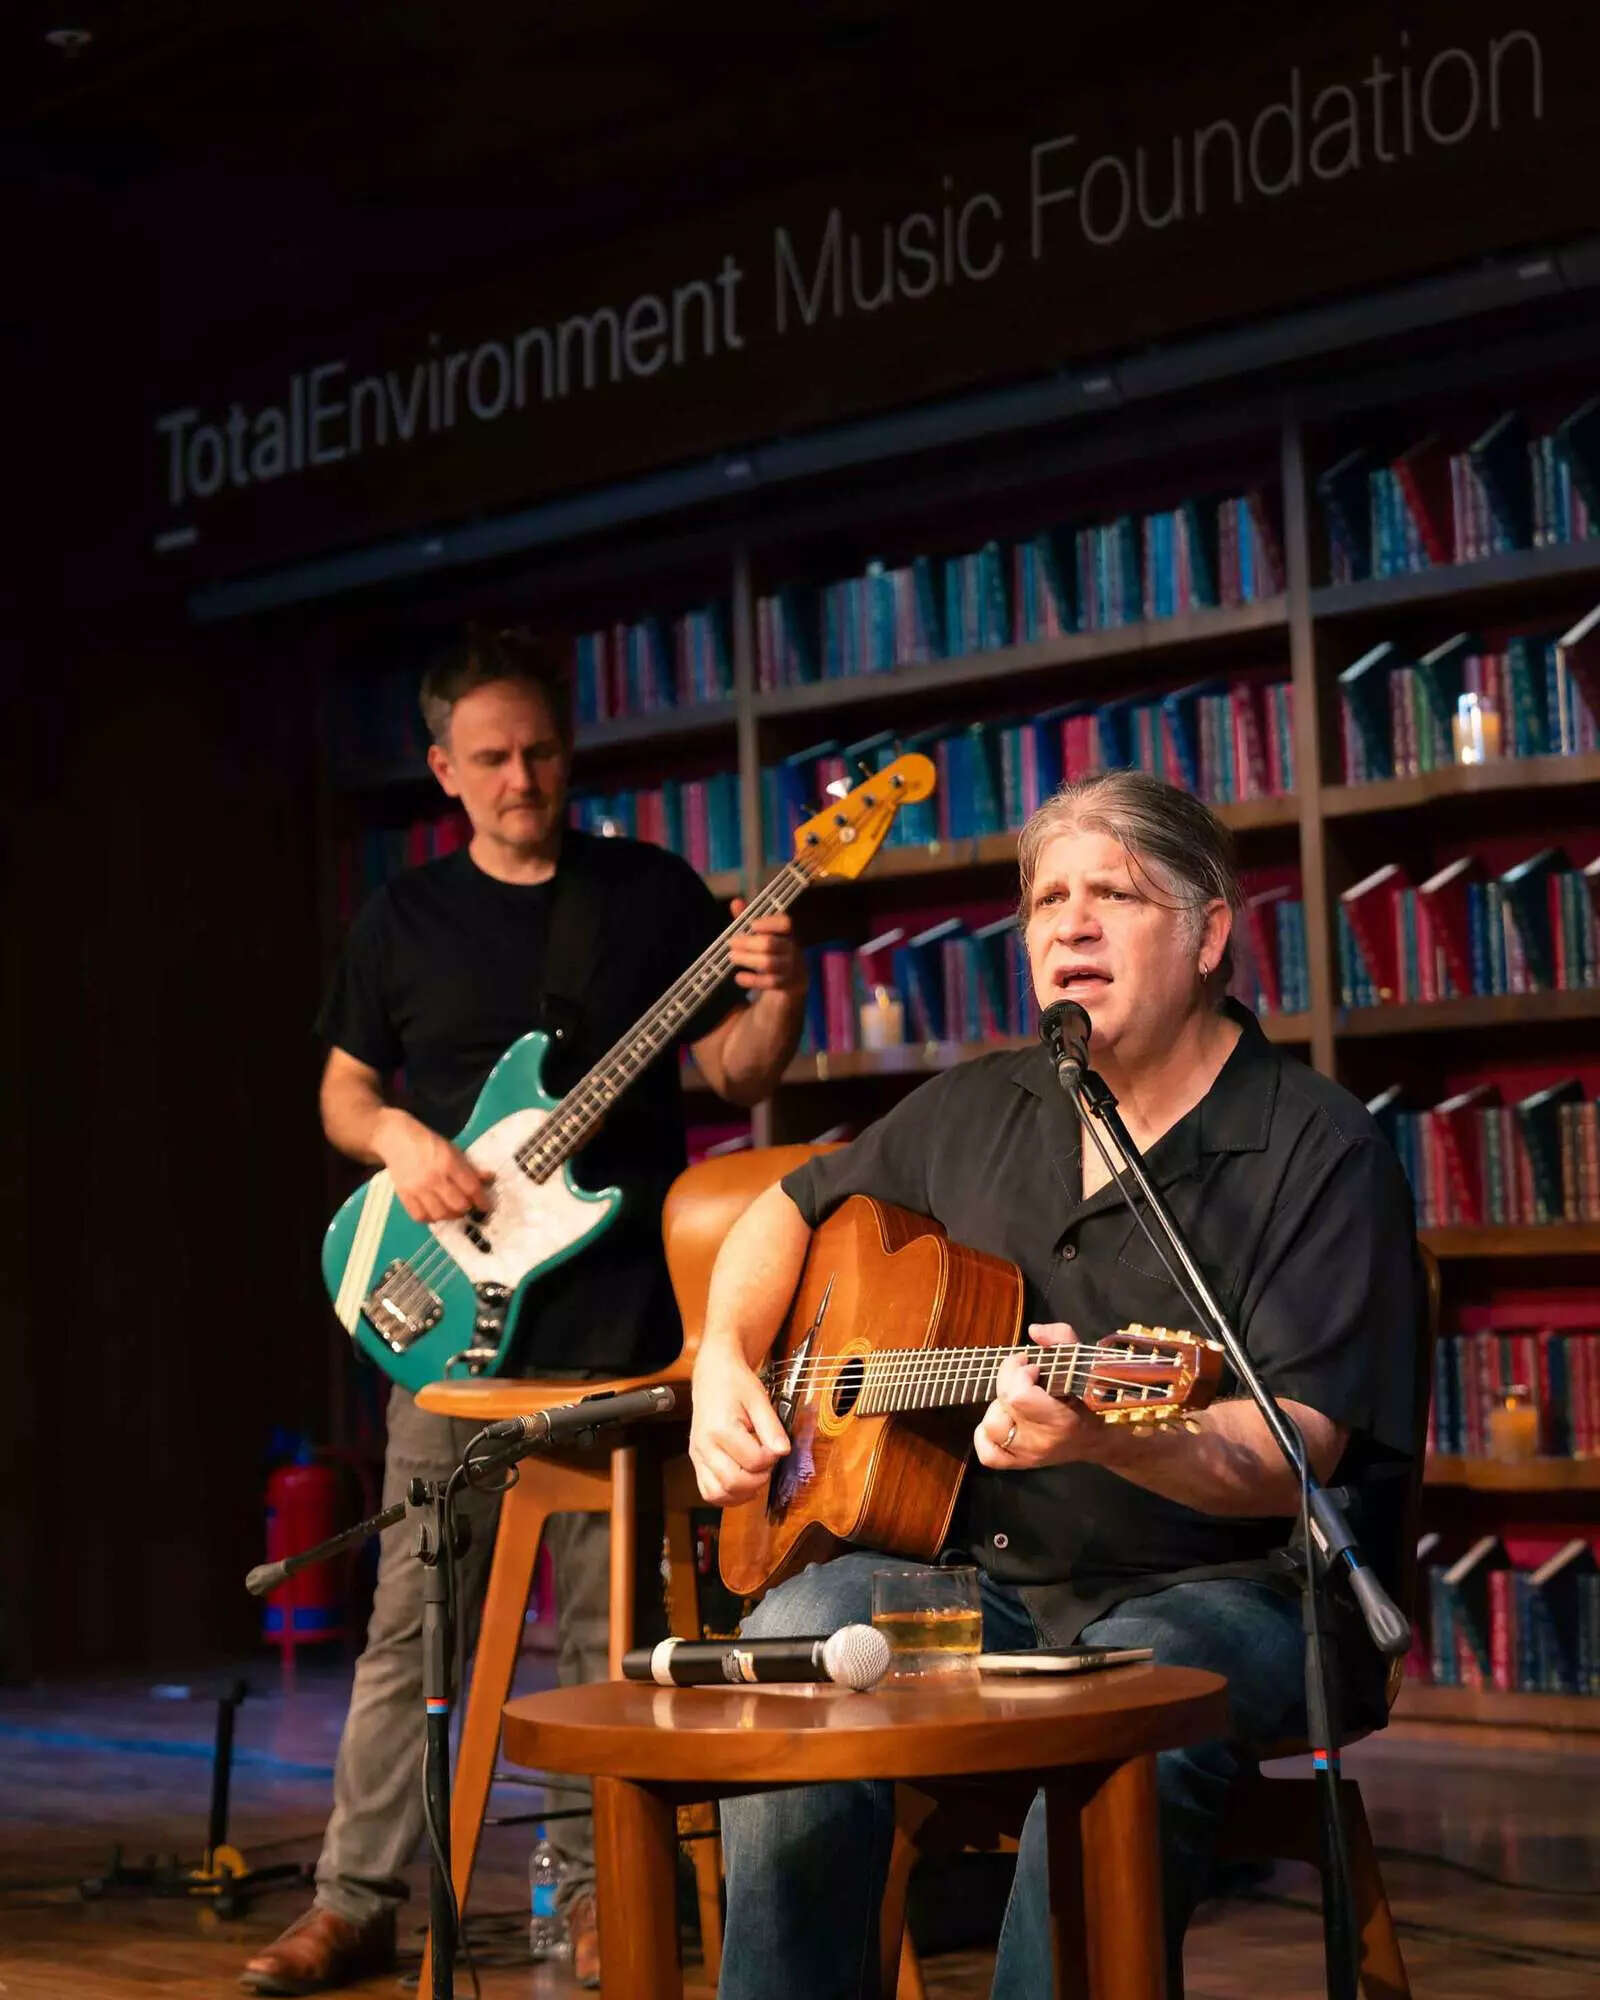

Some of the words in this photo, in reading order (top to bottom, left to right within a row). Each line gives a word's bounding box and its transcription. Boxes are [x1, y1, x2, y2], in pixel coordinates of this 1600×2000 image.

[154, 253, 745, 507] TotalEnvironment
[773, 176, 1007, 332] Music
[1029, 27, 1546, 261] Foundation
